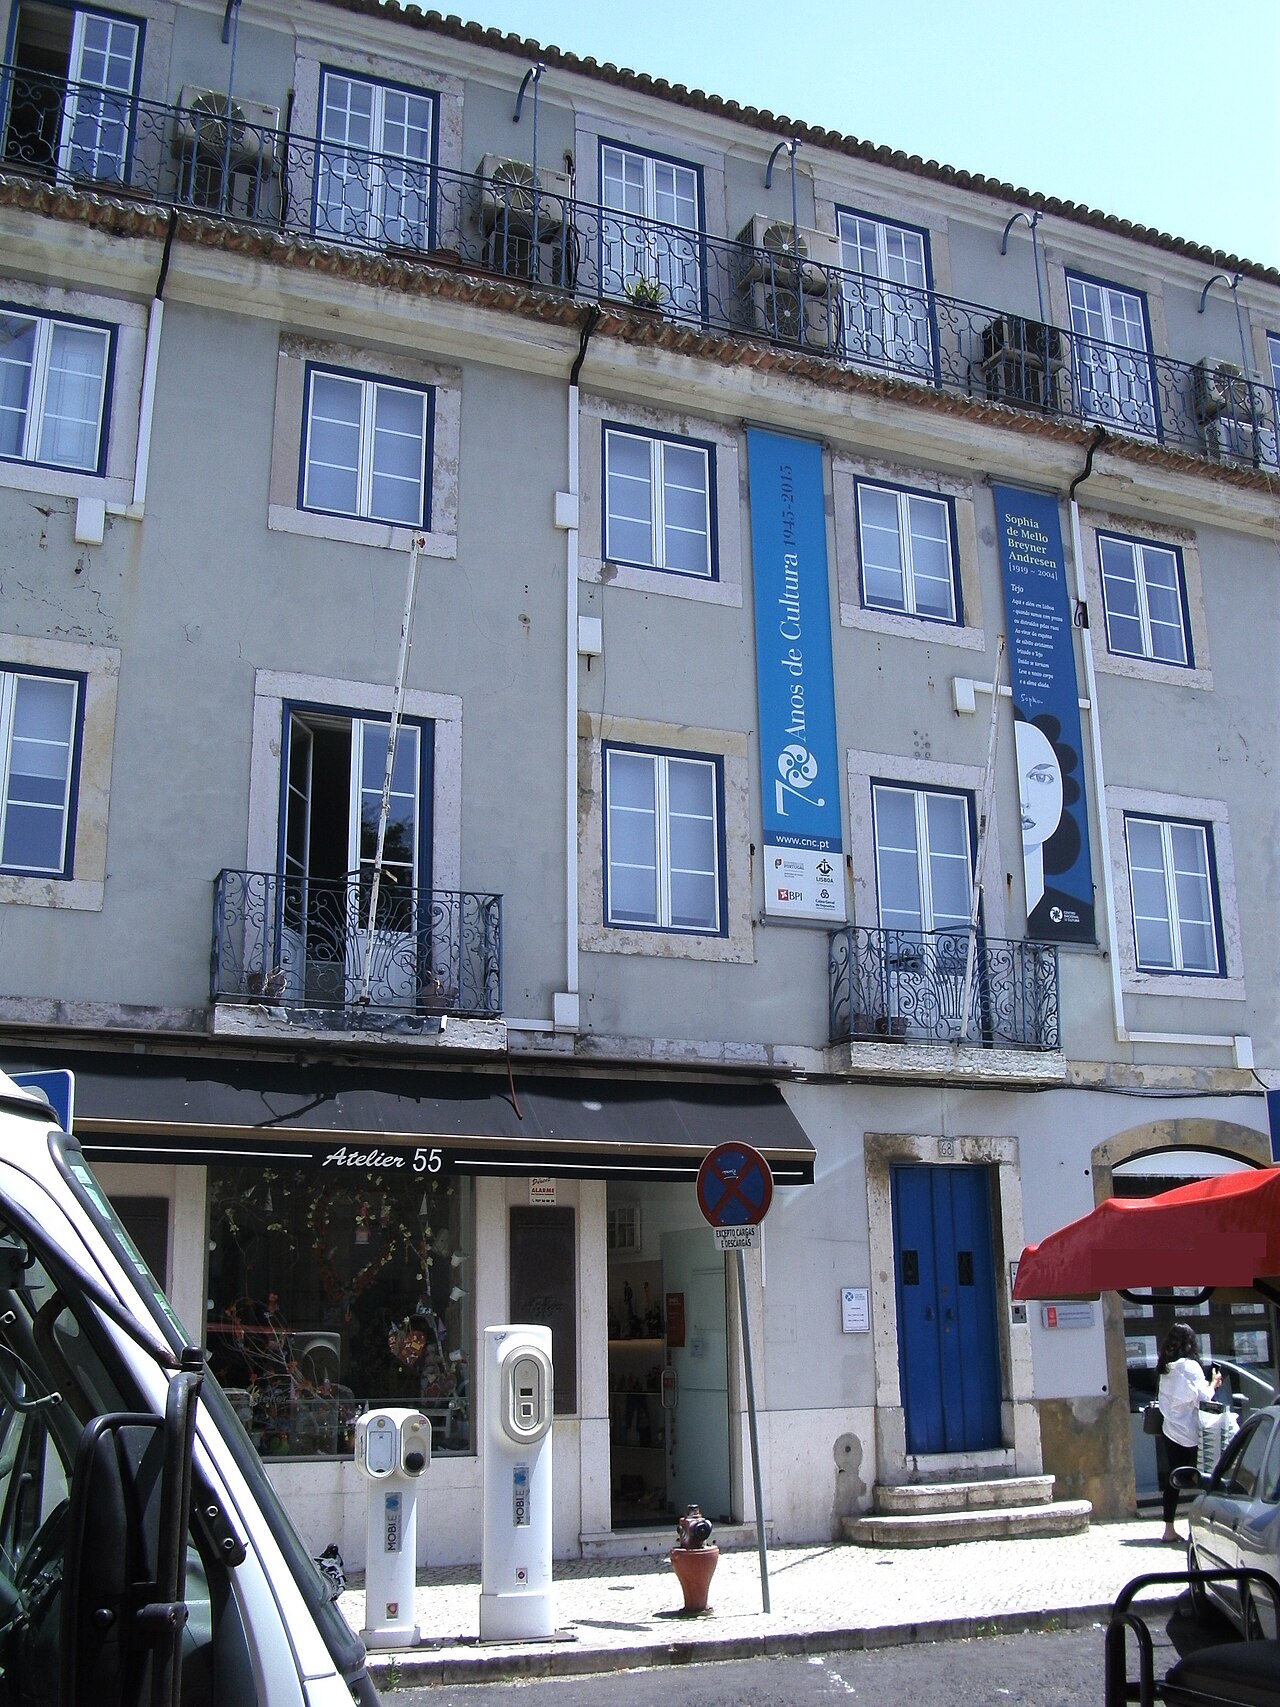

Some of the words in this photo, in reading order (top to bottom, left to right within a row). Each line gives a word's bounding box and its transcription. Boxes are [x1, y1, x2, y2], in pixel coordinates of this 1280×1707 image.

[779, 465, 796, 547] 1945-2015
[1005, 513, 1039, 529] Sophia
[1006, 526, 1019, 537] de
[1021, 529, 1049, 543] Mello
[1007, 538, 1047, 554] Breyner
[1008, 551, 1057, 569] Andresen
[778, 552, 801, 641] Cultura
[1010, 583, 1024, 594] Tejo
[781, 648, 804, 677] de
[785, 684, 806, 743] Anos
[775, 835, 830, 850] www.cnc.pt
[789, 890, 803, 901] BPI
[941, 1142, 953, 1156] 68
[321, 1146, 406, 1168] Atelier
[412, 1148, 443, 1173] 55
[716, 1228, 736, 1238] EXCEPTO
[736, 1227, 755, 1237] CARGAS
[720, 1240, 725, 1248] E
[725, 1238, 752, 1248] DESCARGAS
